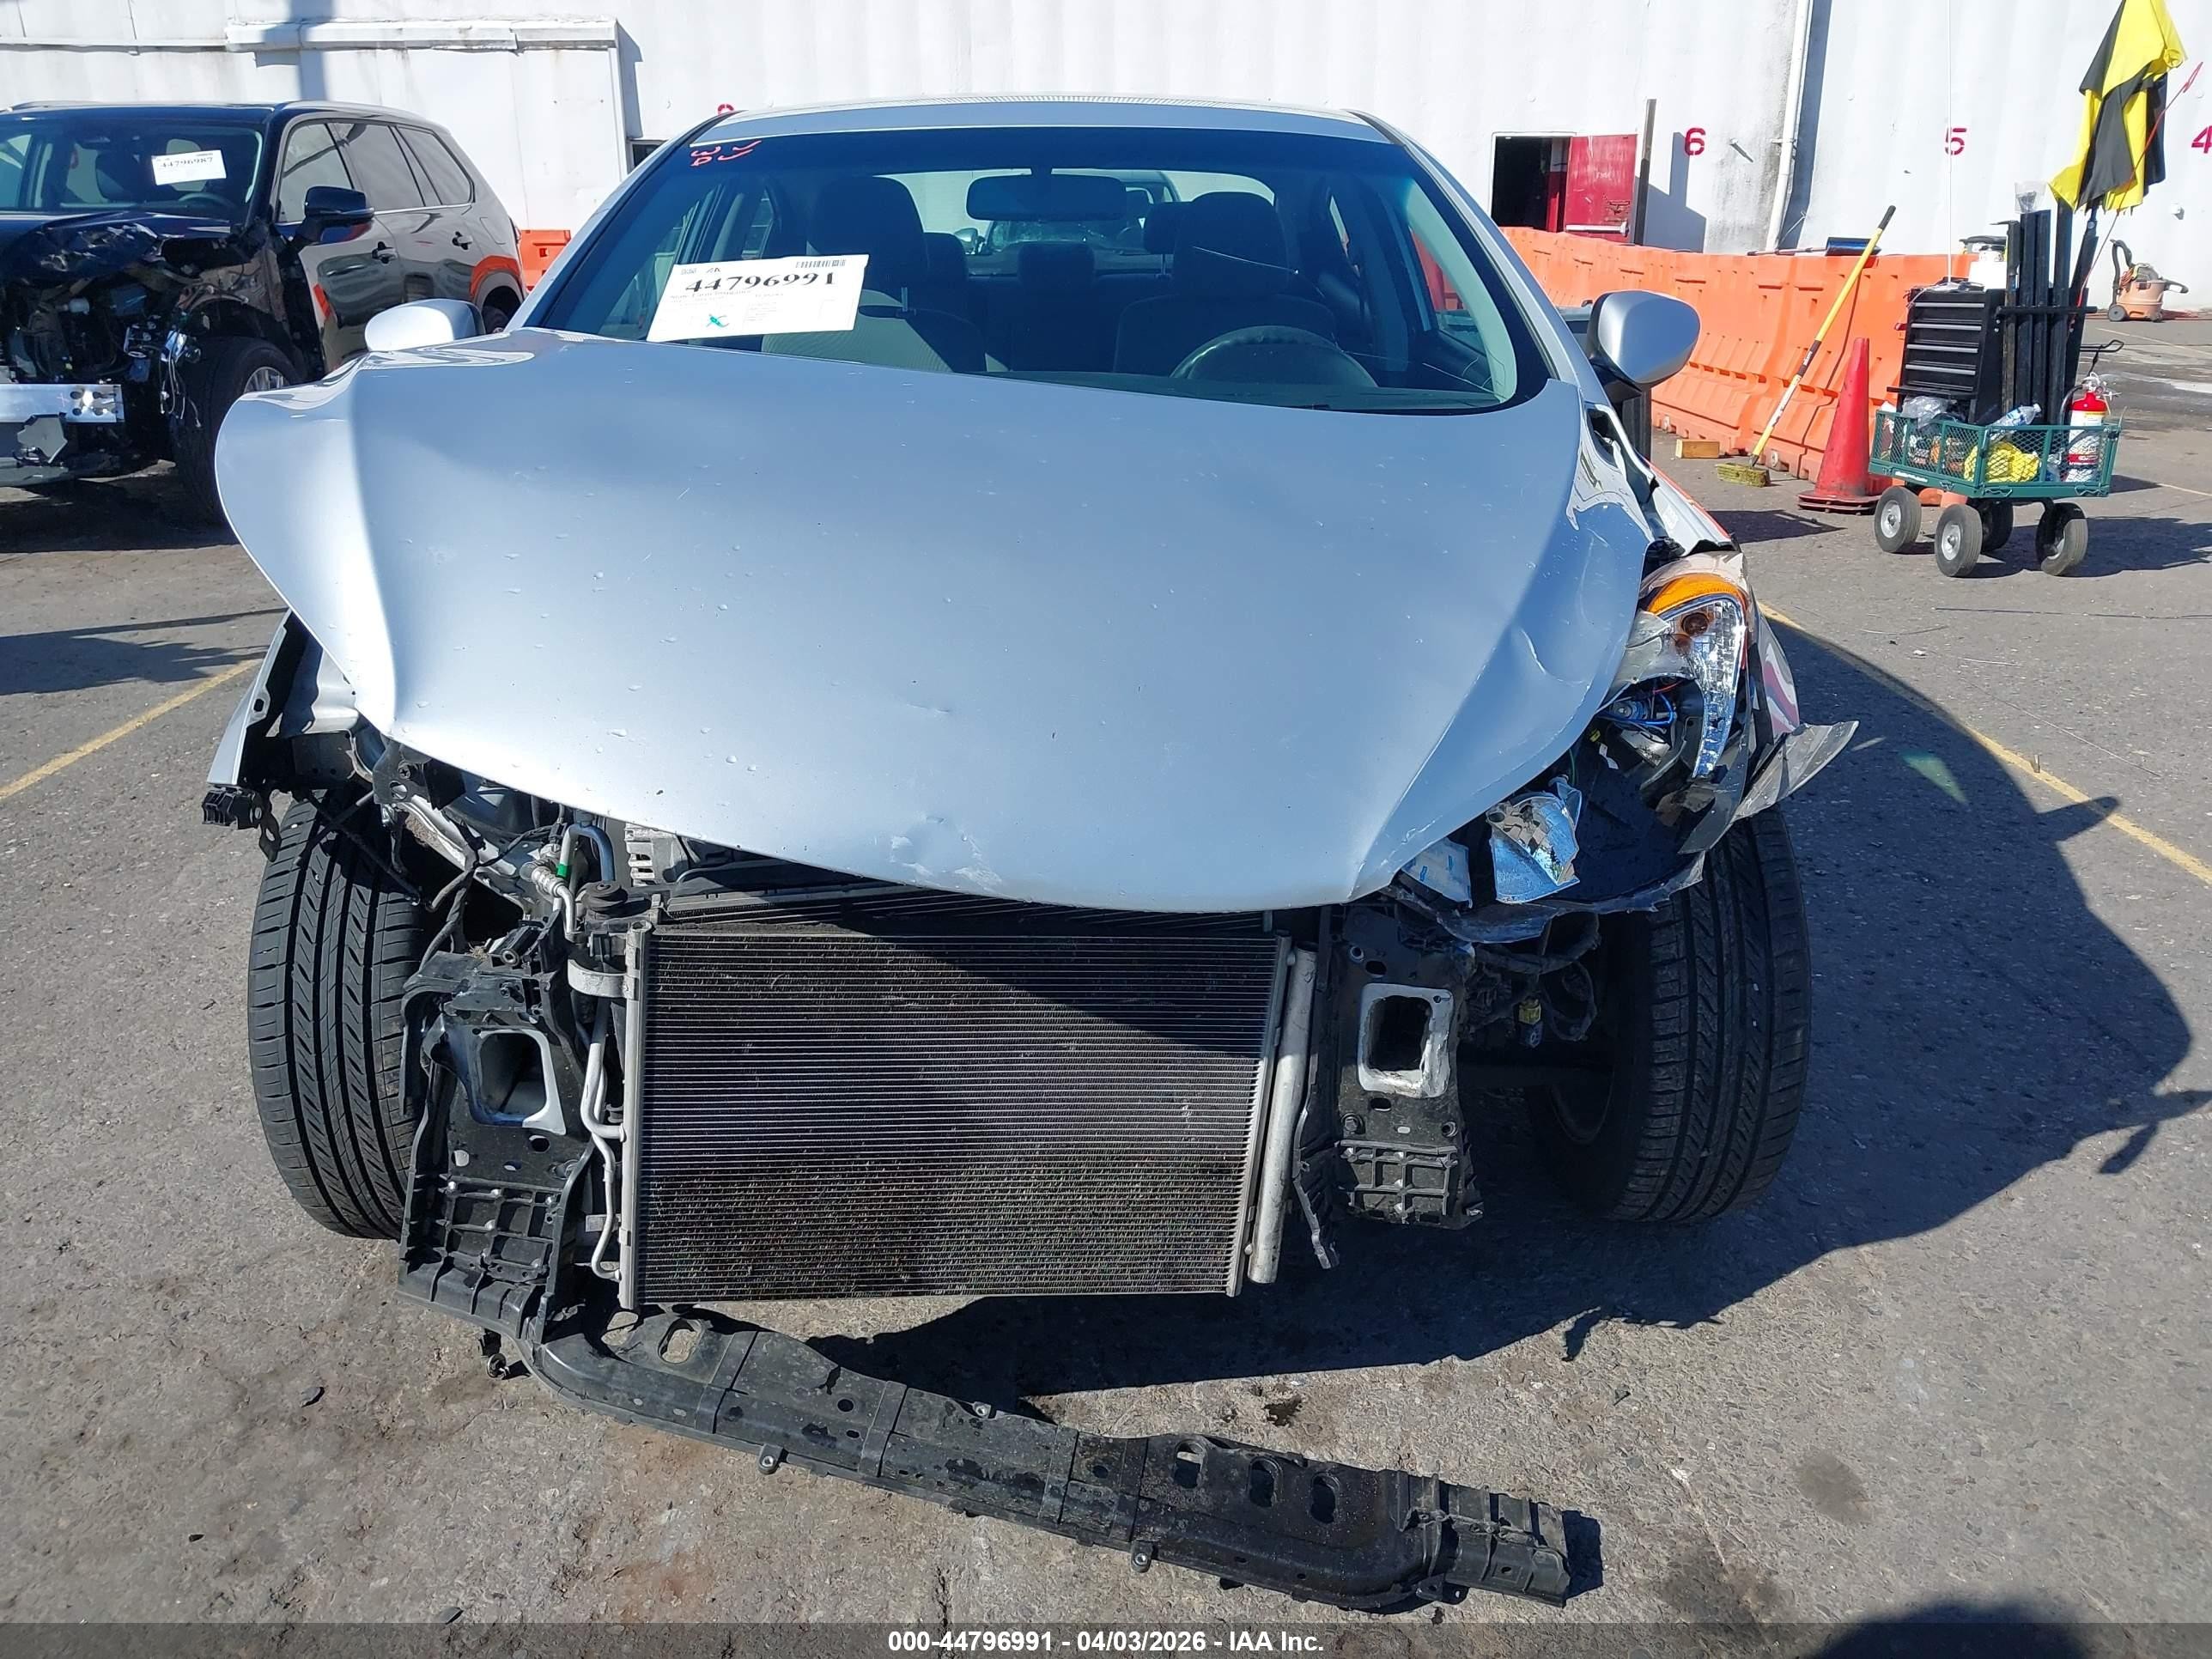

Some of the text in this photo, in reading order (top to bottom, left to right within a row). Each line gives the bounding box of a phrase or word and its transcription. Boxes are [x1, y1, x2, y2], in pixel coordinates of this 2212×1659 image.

[1684, 127, 1706, 156] 6
[1945, 127, 1966, 155] 5
[2191, 125, 2212, 154] 4
[685, 271, 836, 292] 44796991
